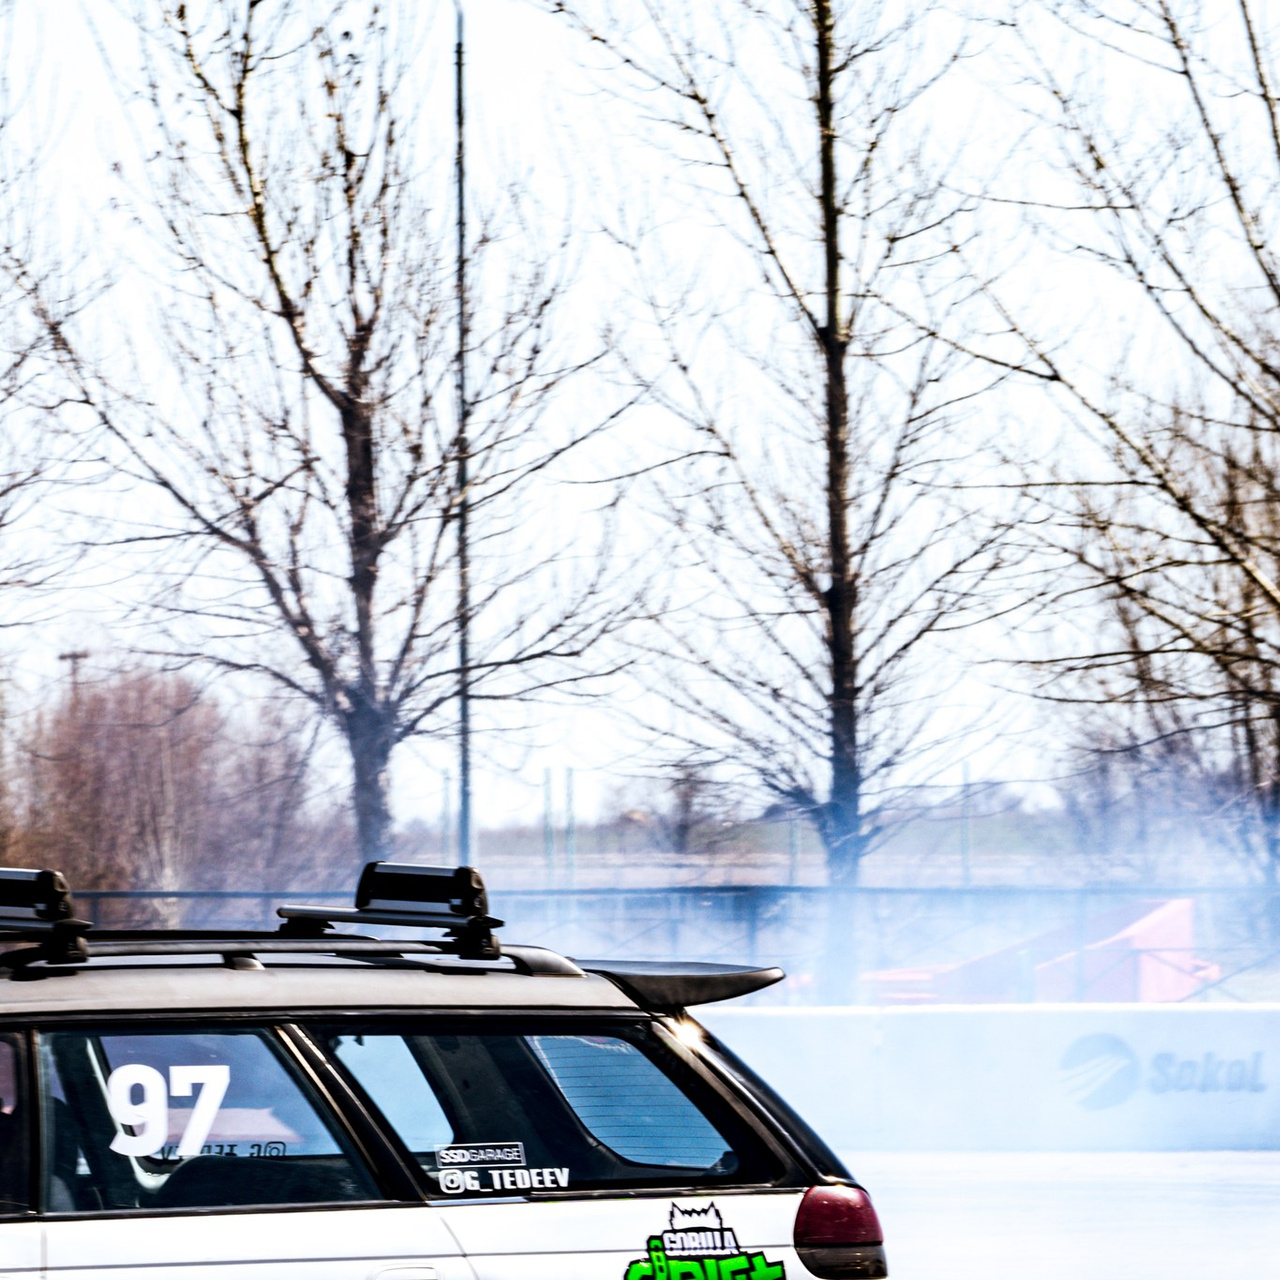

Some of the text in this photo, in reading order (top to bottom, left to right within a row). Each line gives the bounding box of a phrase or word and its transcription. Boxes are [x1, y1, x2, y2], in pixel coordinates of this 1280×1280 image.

[107, 1063, 231, 1157] 97
[439, 1147, 522, 1164] SSDGARAGE
[662, 1230, 740, 1257] GORILLA
